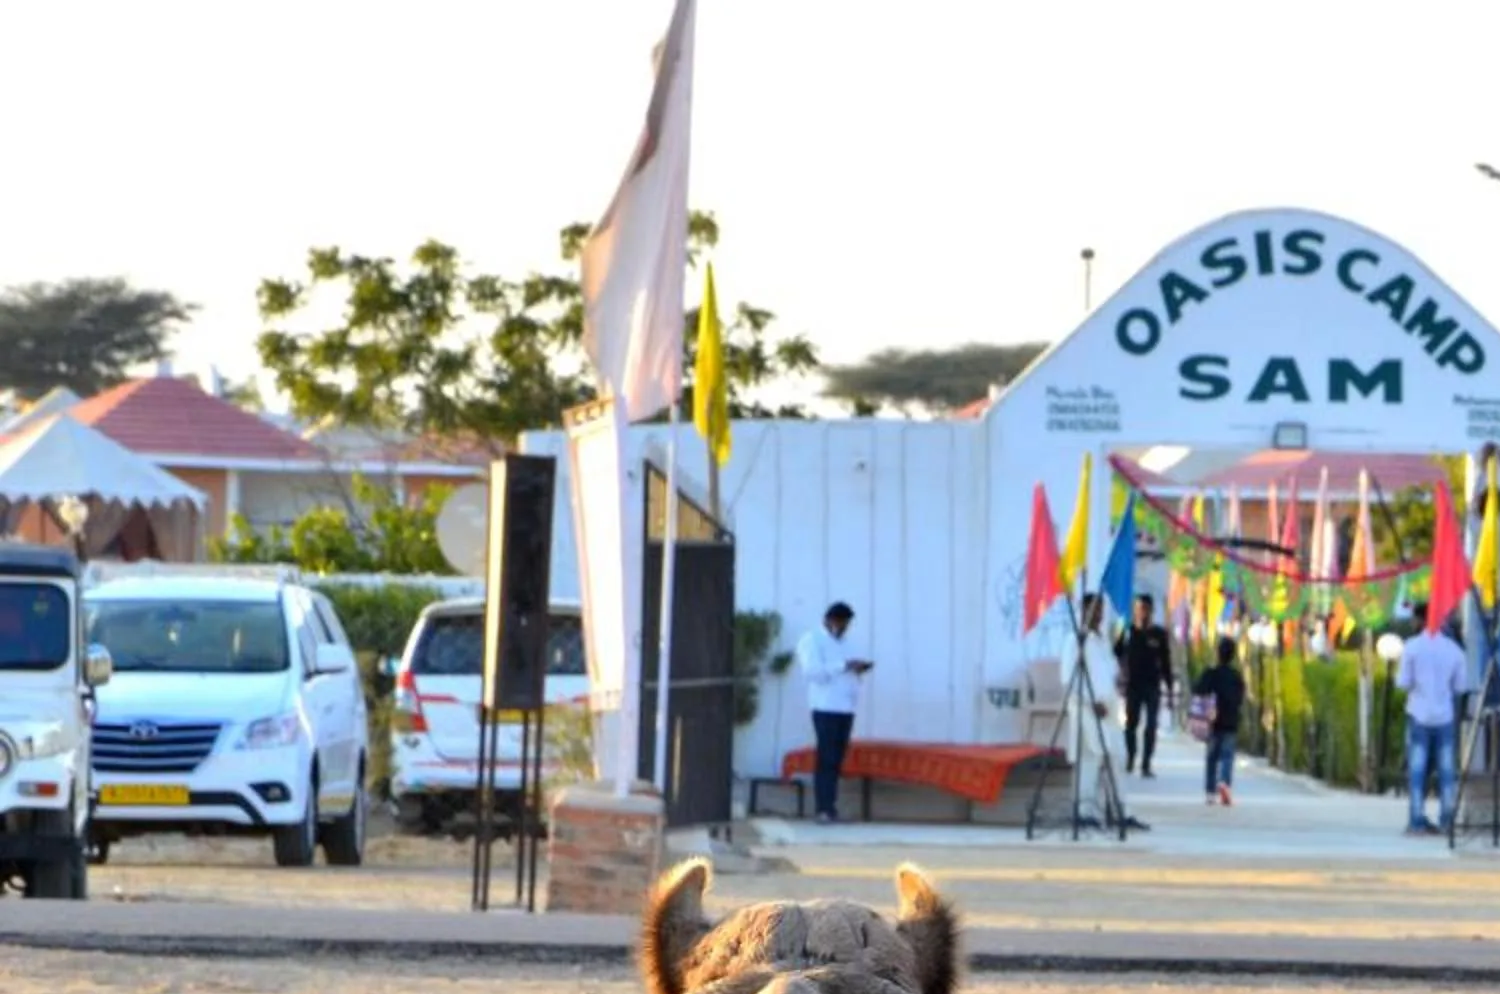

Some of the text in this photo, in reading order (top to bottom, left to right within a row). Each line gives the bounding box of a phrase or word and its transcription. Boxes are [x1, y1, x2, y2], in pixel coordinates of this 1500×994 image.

[1115, 228, 1486, 376] OASIS CAMP
[1178, 354, 1404, 404] SAM
